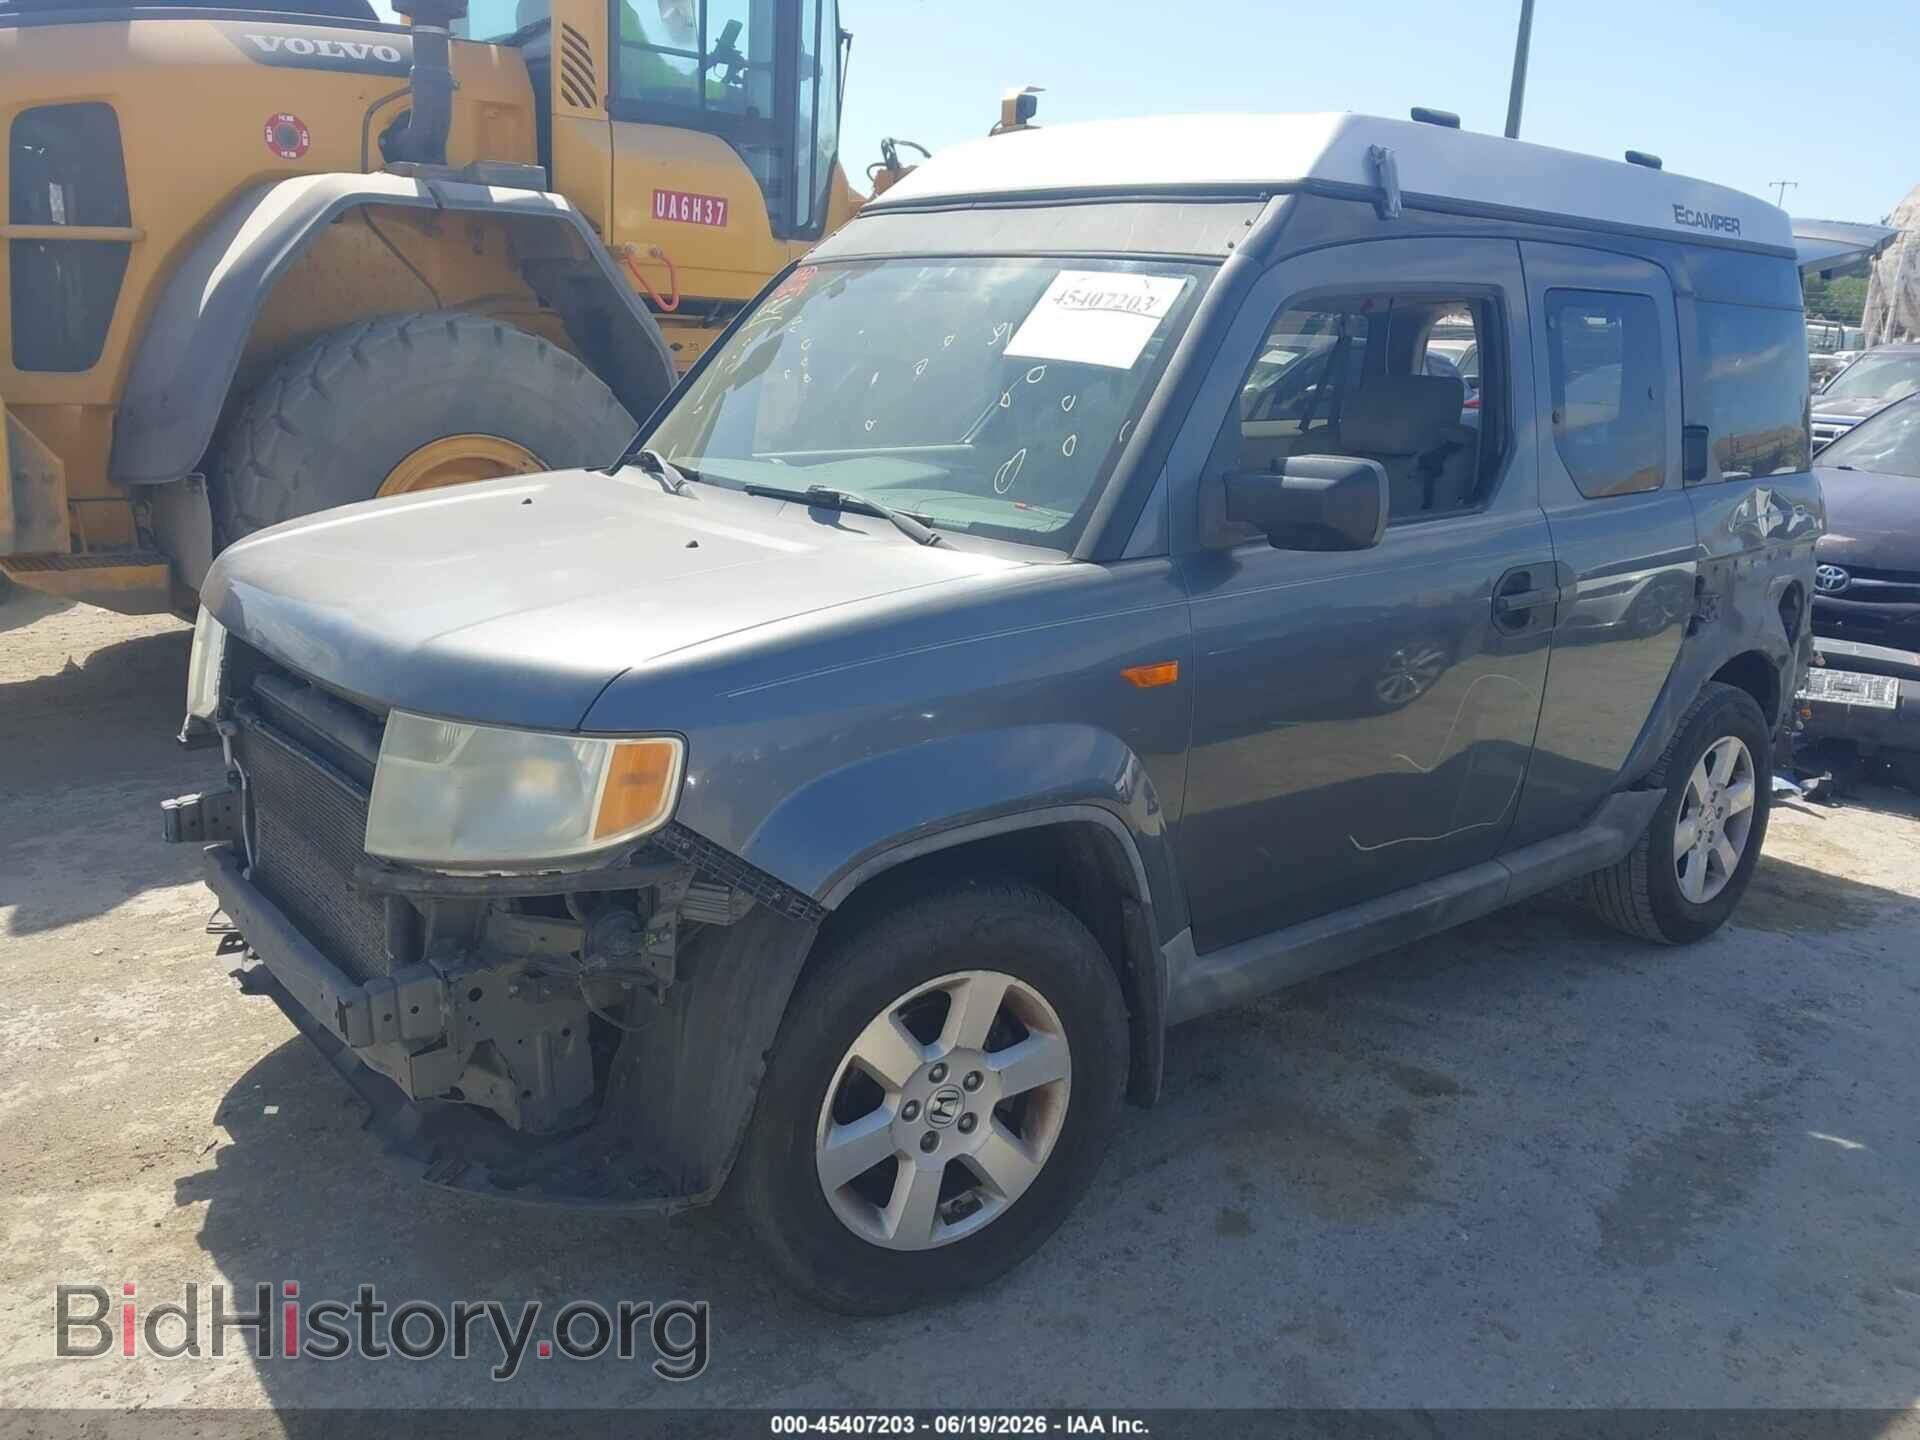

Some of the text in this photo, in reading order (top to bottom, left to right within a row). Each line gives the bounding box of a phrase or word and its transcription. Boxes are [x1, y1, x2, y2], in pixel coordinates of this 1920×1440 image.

[245, 34, 401, 63] VOLVO
[656, 192, 725, 225] UA6H37
[1672, 204, 1741, 238] ECAMPER
